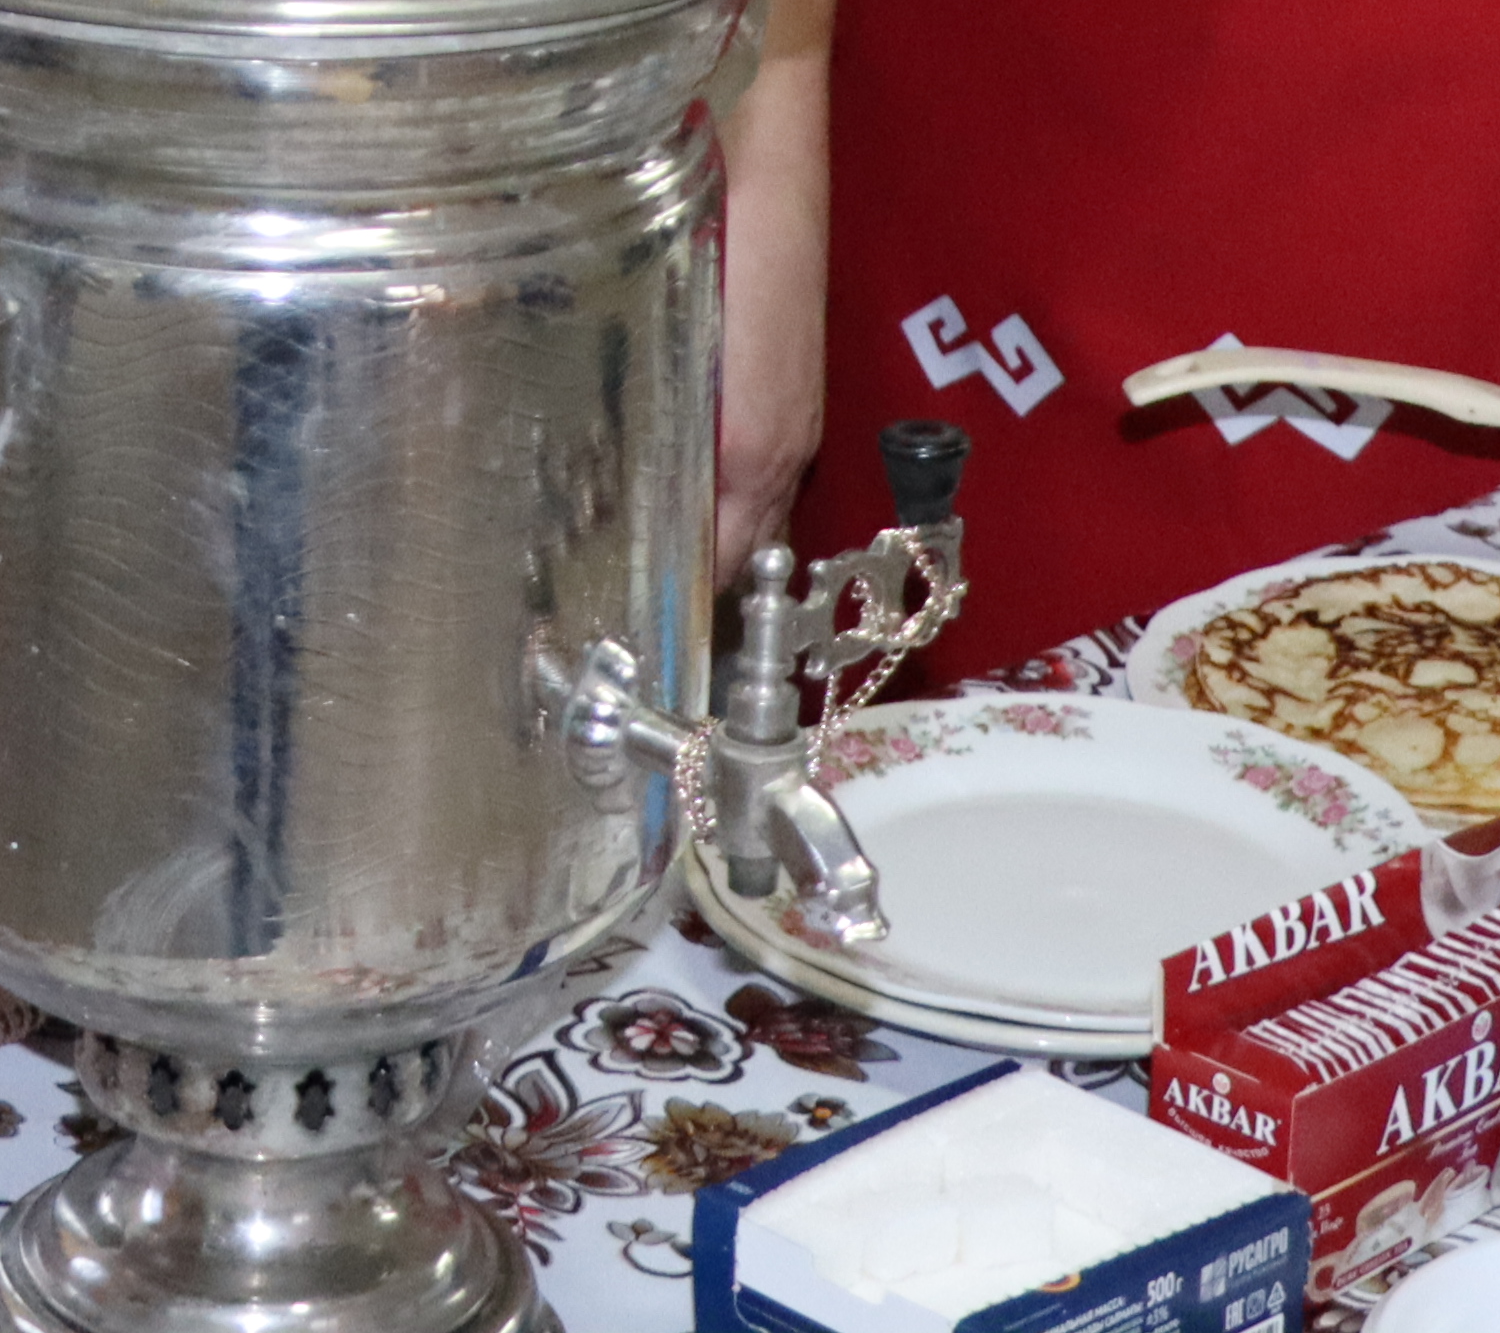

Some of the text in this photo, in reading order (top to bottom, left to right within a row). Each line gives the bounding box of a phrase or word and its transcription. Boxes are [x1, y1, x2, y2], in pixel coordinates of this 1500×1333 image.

[1187, 869, 1386, 994] AKBAR
[1163, 1077, 1277, 1146] AKBAR
[1228, 1226, 1288, 1278] РУСАГРО
